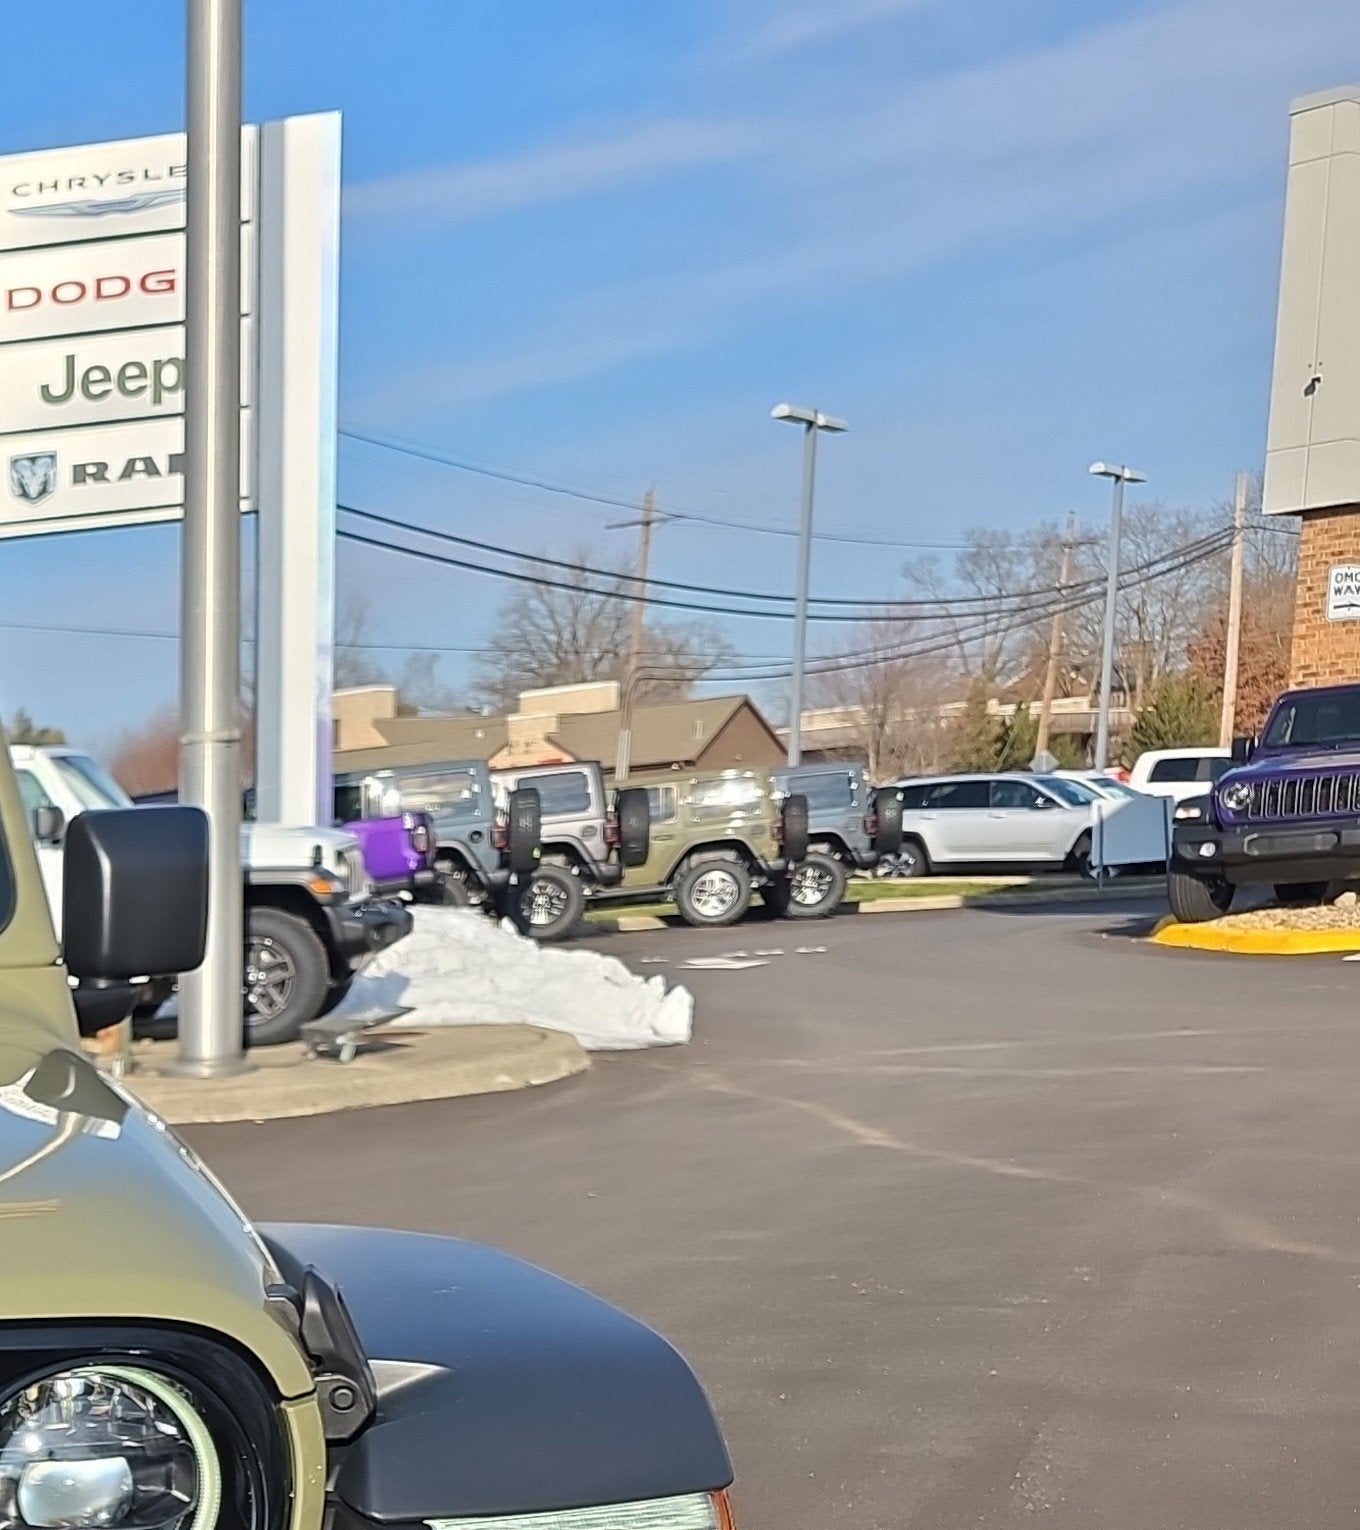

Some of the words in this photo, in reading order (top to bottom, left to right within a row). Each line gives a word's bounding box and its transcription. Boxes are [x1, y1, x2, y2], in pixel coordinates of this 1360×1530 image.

[11, 164, 187, 196] CHRYSLE
[7, 269, 177, 310] DODG
[40, 354, 186, 406] Jeep
